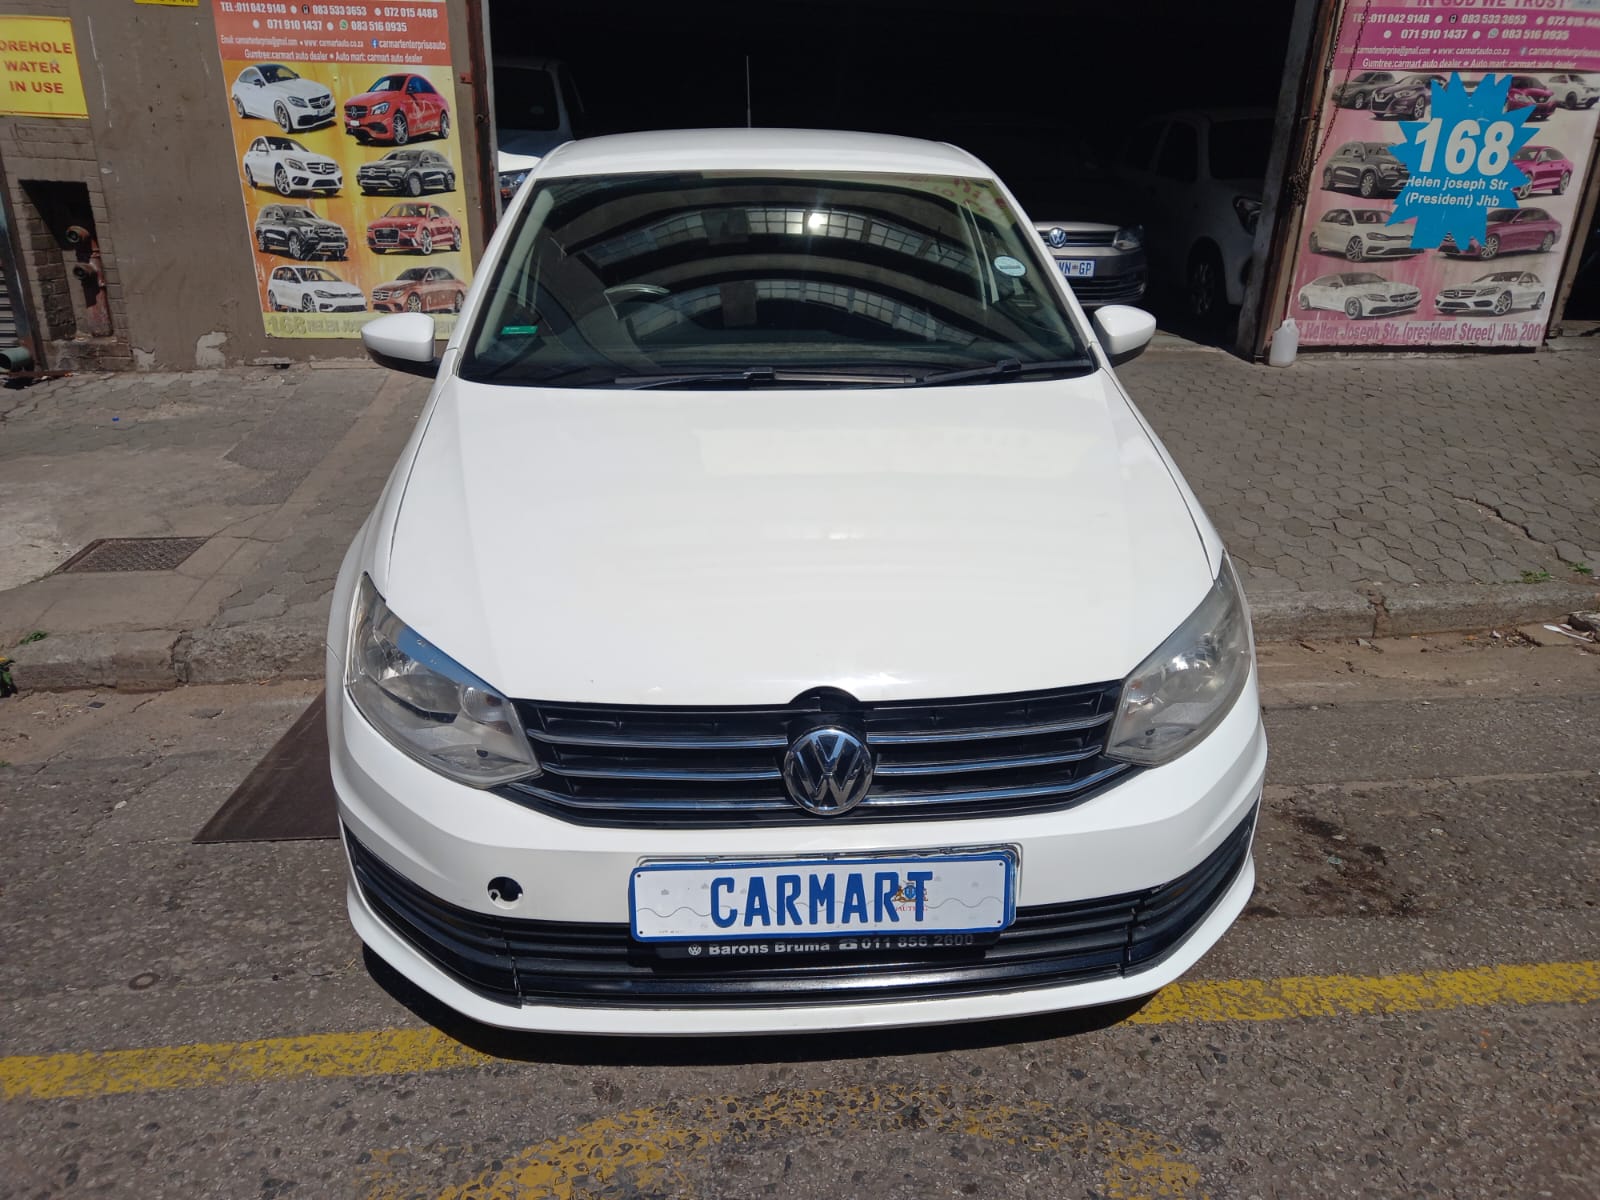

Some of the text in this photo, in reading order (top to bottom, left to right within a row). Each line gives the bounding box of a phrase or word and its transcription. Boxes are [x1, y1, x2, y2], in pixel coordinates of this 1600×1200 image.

[330, 6, 345, 15] 533
[384, 7, 399, 16] 072
[400, 8, 416, 17] 015
[1406, 14, 1430, 23] 9148
[267, 19, 408, 32] 071 910 1437 083 516 0935
[1401, 29, 1419, 39] 071
[1421, 29, 1441, 39] 910
[1443, 29, 1468, 39] 1437
[1502, 29, 1521, 39] 083
[4, 60, 61, 74] WATER
[9, 80, 64, 94] IN USE
[1414, 117, 1514, 176] 168
[1406, 176, 1440, 188] Helen
[1443, 176, 1486, 192] joseph
[1405, 192, 1500, 208] (President) Jhb
[710, 871, 933, 928] CARMART
[709, 944, 769, 955] Barons
[775, 942, 830, 953] Bruma
[861, 938, 891, 949] 011
